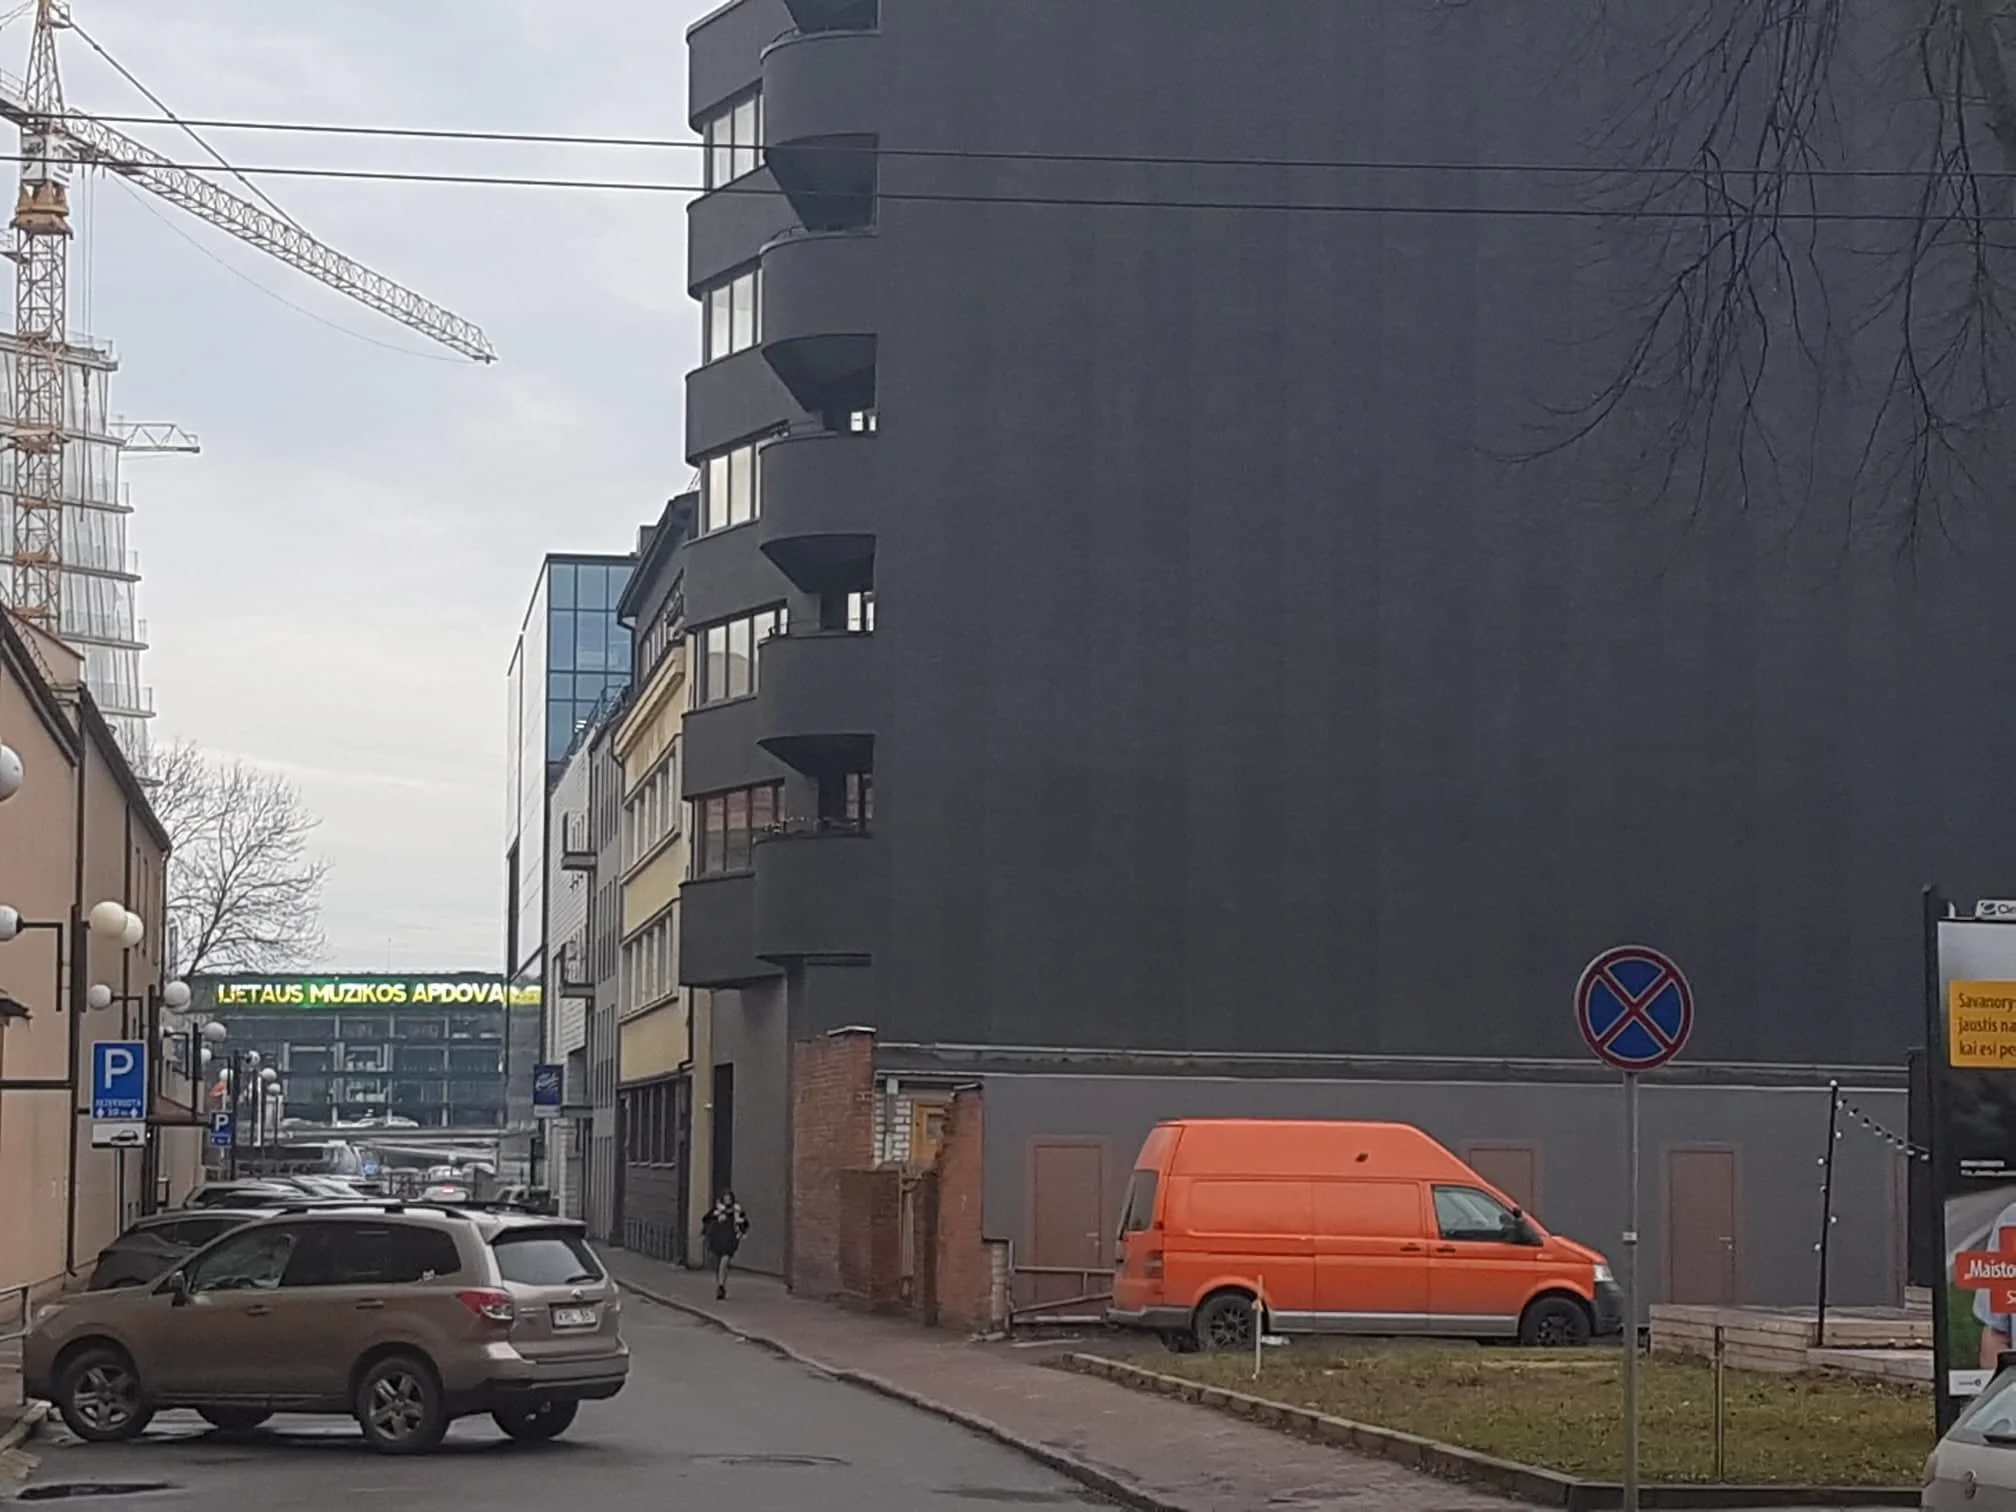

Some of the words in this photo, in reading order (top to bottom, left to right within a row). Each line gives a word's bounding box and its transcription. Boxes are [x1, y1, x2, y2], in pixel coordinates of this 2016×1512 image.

[1957, 1016, 1998, 1035] jaustis
[1960, 1040, 1977, 1056] kai
[1979, 1041, 1997, 1056] esi
[105, 1048, 134, 1089] P
[216, 1114, 229, 1131] P
